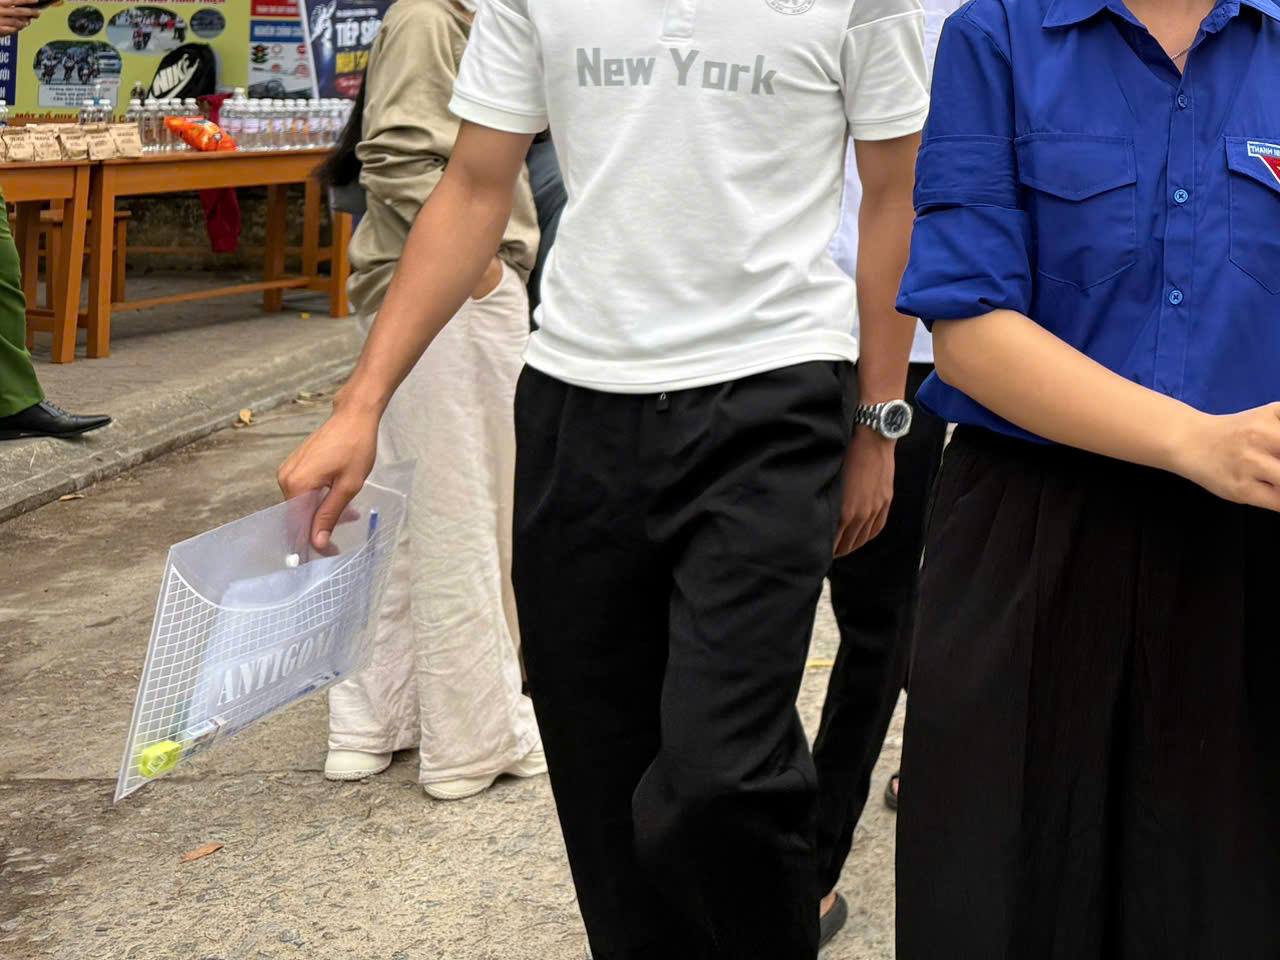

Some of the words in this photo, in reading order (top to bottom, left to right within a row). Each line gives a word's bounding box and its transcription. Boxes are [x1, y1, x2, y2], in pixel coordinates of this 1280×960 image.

[152, 53, 192, 94] NIKE
[575, 48, 656, 87] New
[669, 48, 778, 95] York
